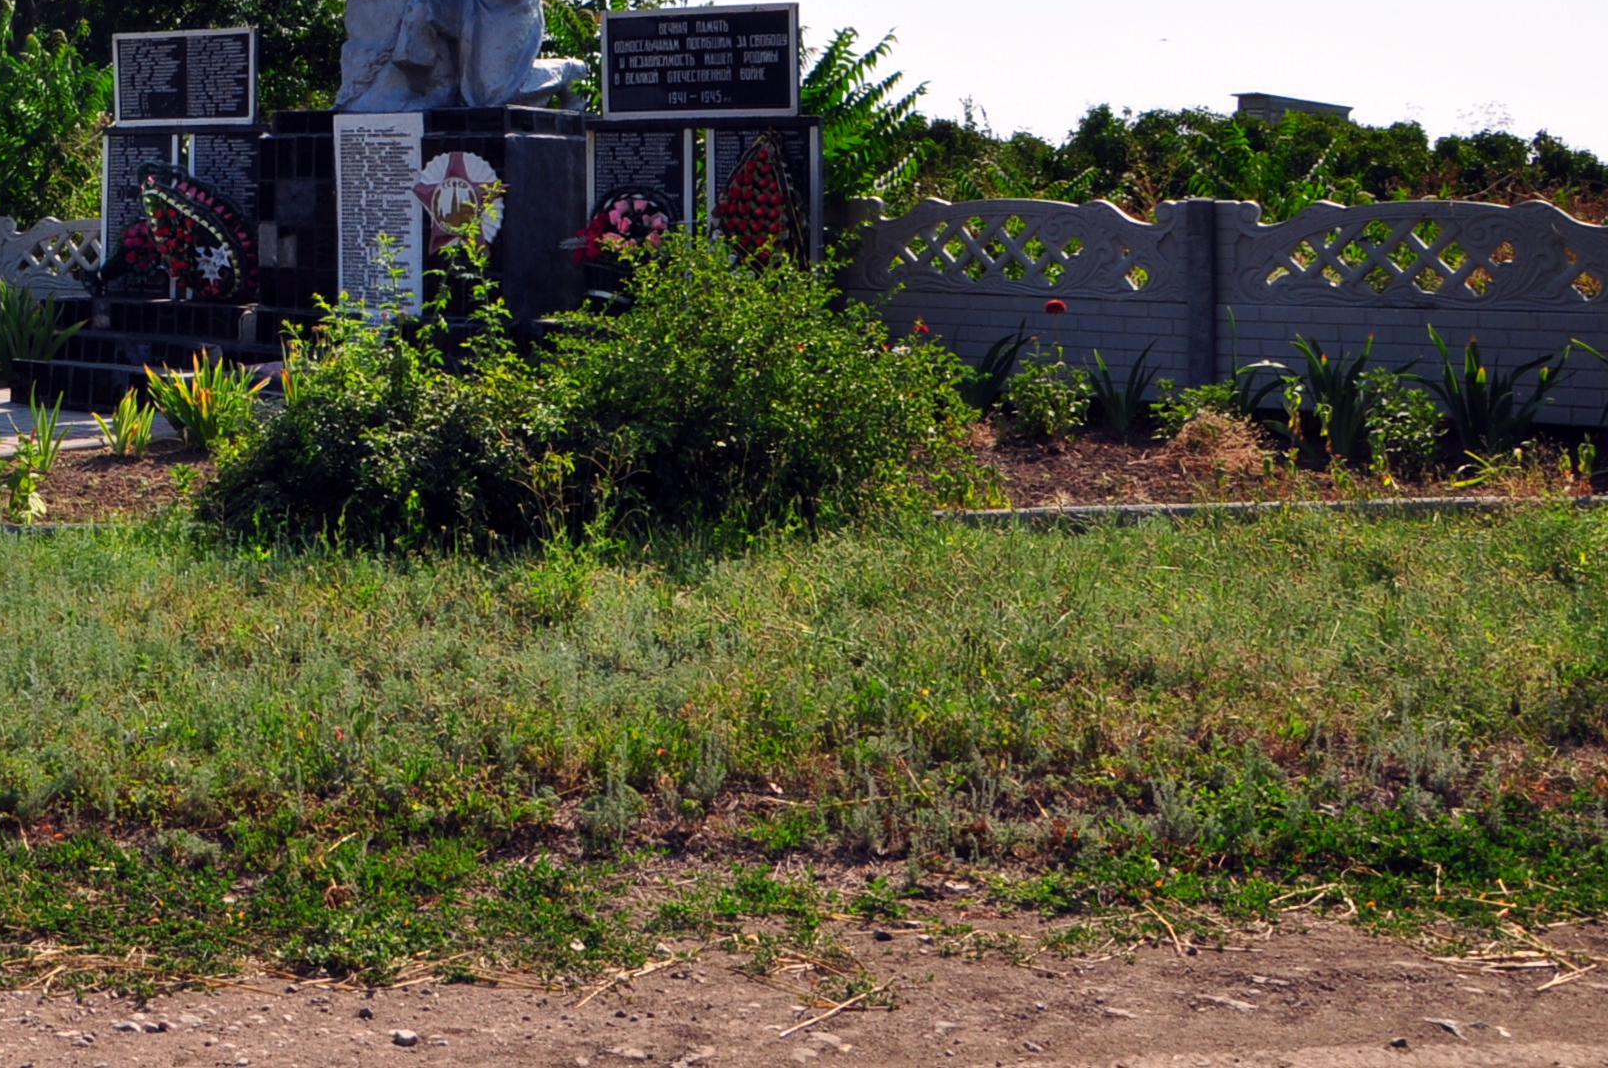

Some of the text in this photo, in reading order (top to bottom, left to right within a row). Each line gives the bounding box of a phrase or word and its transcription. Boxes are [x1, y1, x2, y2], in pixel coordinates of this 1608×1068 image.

[658, 19, 729, 35] ВЕЧНАЯ ПАМЯТЬ
[614, 33, 788, 53] ОДНОСЕЛЬЧАНАМ ПОГИБШИМ ЗА СВОБОДУ
[619, 57, 626, 69] И
[629, 54, 696, 68] НЕЗАВИСИМОСТЬ
[743, 50, 779, 65] РОДИНЫ
[614, 65, 766, 86] В ВЕЛИКОЙ ОТЕЧЕСТВЕННОЙ ВОЙНЕ
[668, 92, 687, 104] 1941
[701, 90, 722, 103] 1945
